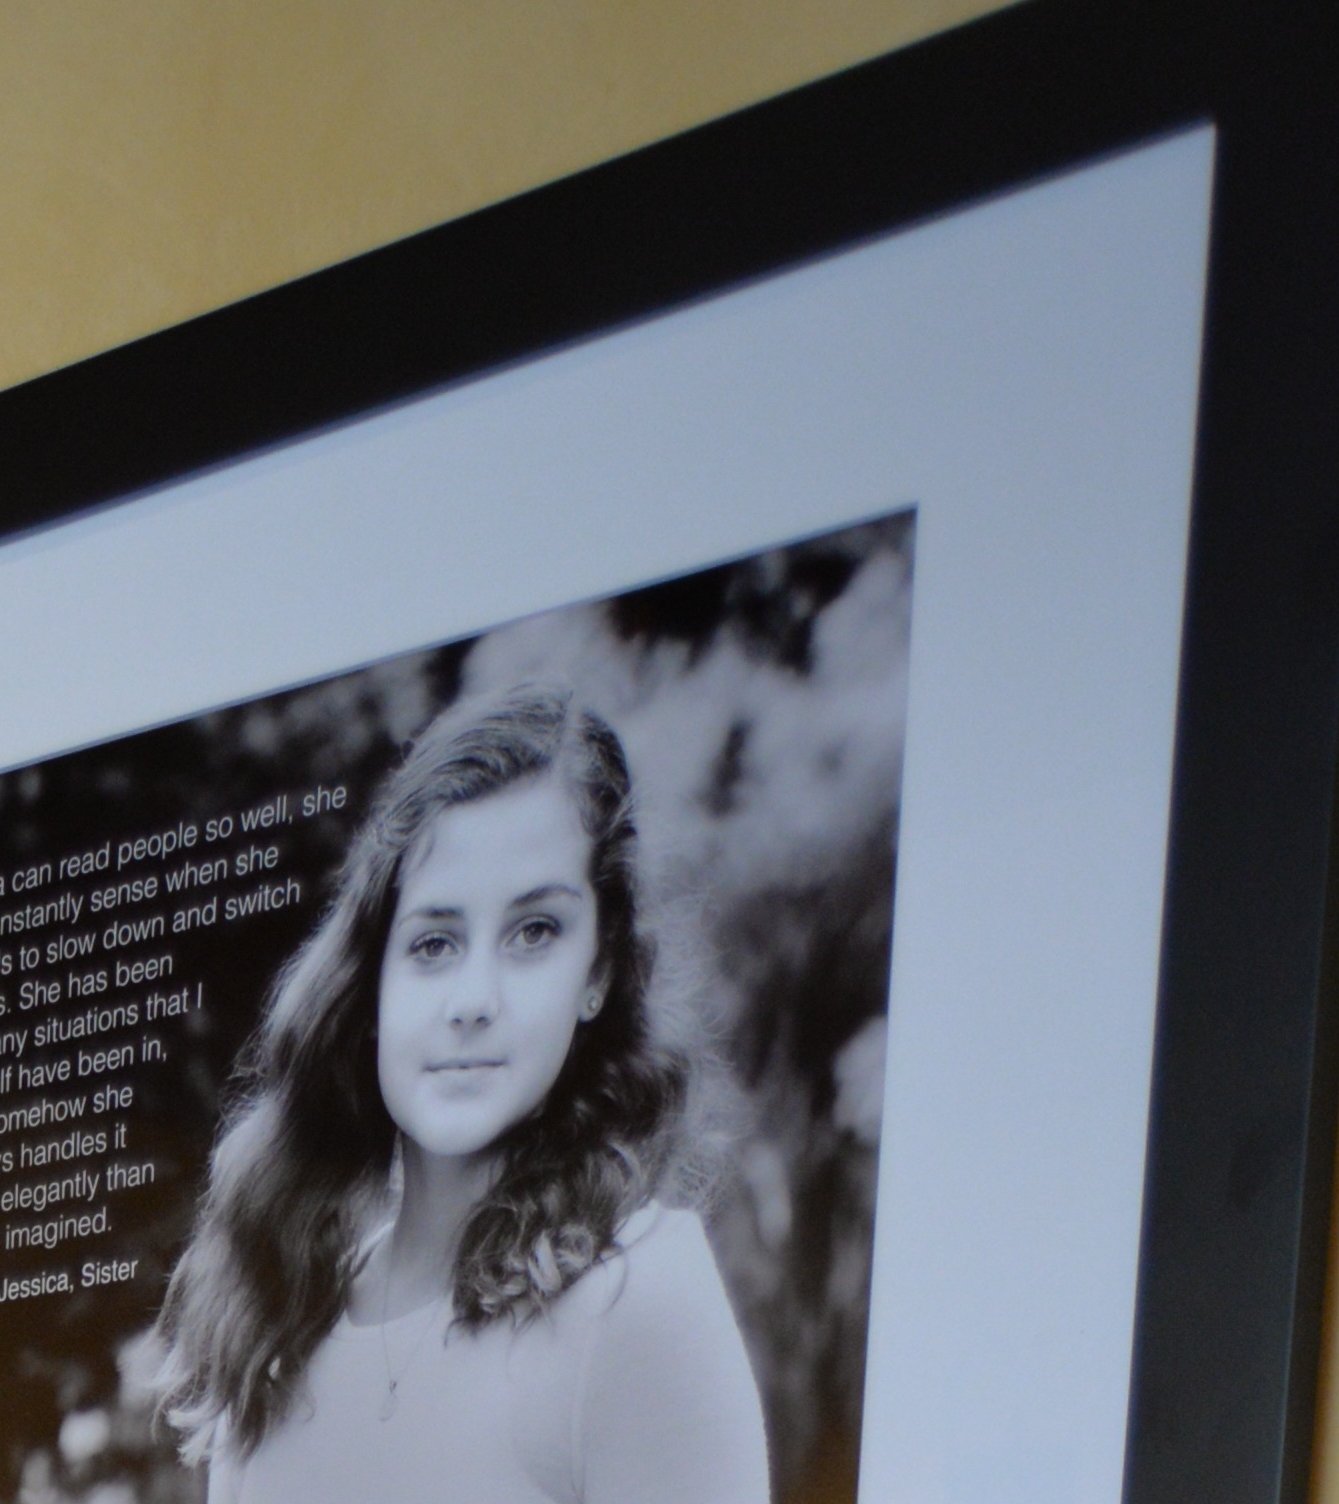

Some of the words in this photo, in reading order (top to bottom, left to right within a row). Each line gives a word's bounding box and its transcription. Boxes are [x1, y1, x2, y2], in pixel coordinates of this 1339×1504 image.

[11, 863, 52, 892] can
[59, 841, 110, 879] read
[117, 821, 198, 871] people
[205, 816, 233, 842] so
[240, 794, 293, 832] well,
[302, 785, 347, 817] she
[90, 876, 158, 912] sense
[165, 858, 228, 892] when
[235, 846, 279, 876] she
[19, 946, 40, 971] to
[46, 932, 96, 964] slow
[102, 916, 165, 950] down
[172, 896, 217, 933] and
[224, 877, 301, 920] switch
[19, 980, 61, 1010] She
[68, 970, 108, 998] has
[115, 954, 173, 987] been
[33, 1004, 139, 1047] situations
[145, 987, 189, 1021] that
[197, 982, 203, 1010] I
[18, 1059, 71, 1089] have
[77, 1044, 134, 1076] been
[142, 1035, 167, 1062] in,
[93, 1084, 133, 1114] she
[20, 1130, 107, 1168] handles
[115, 1122, 127, 1149] it
[0, 1169, 100, 1212] elegantly
[105, 1162, 155, 1192] than
[5, 1206, 112, 1250] imagined.
[81, 1259, 139, 1288] Sister
